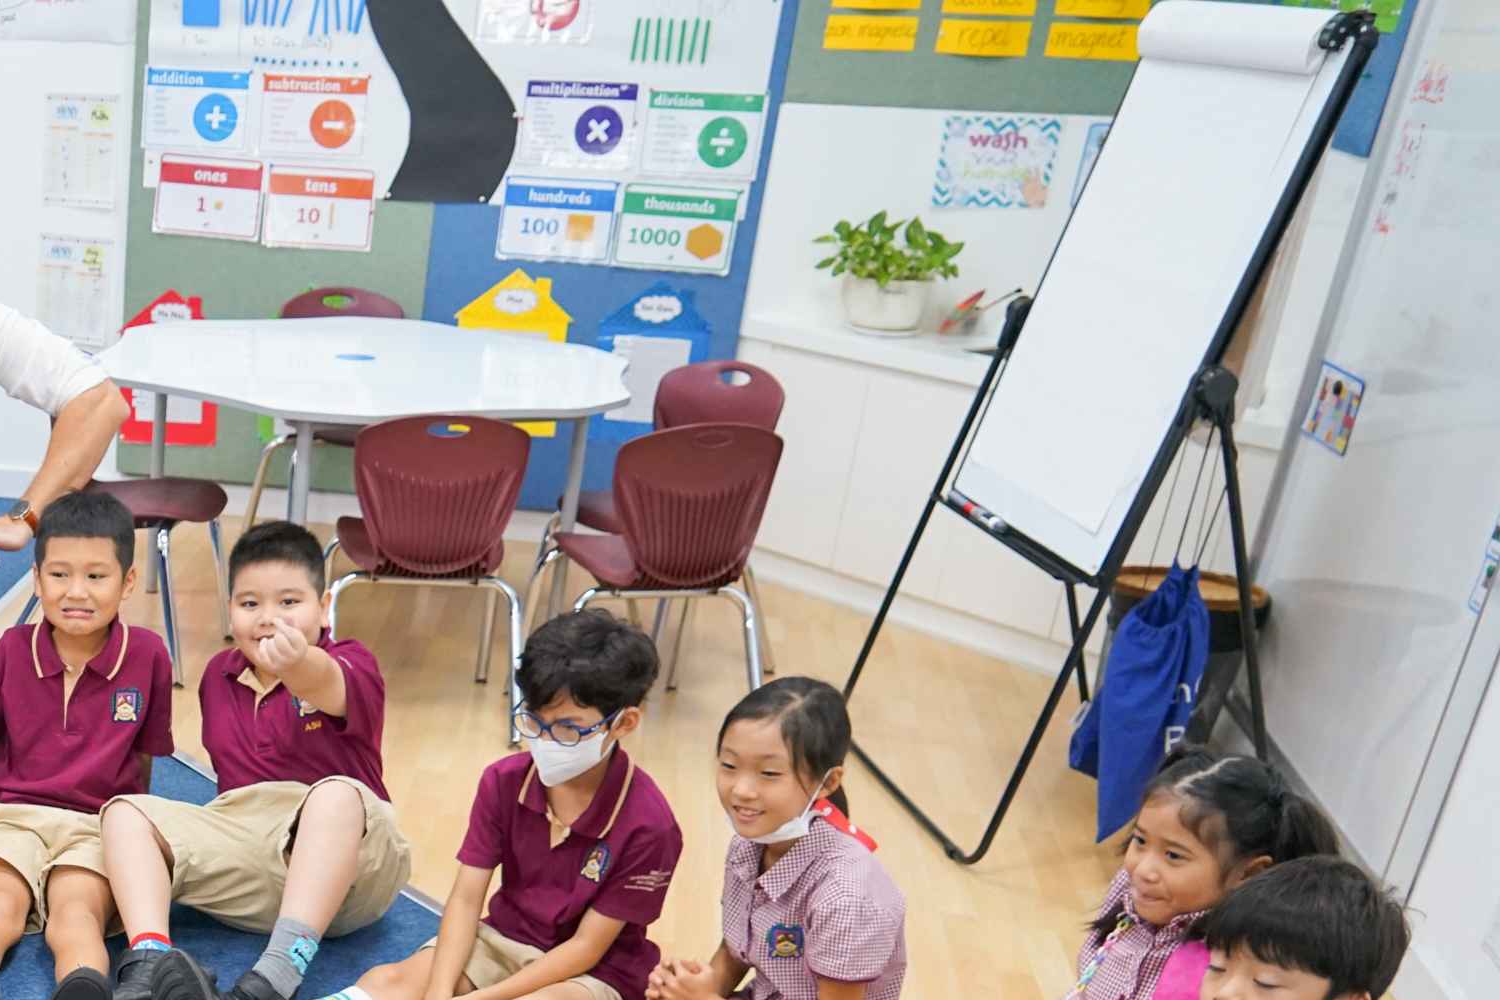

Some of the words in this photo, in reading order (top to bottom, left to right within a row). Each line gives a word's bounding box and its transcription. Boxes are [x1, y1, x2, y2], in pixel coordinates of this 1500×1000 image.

[957, 21, 1010, 50] repel
[1051, 30, 1128, 57] magnet
[151, 71, 204, 86] addition
[267, 78, 341, 92] subtraction
[530, 81, 620, 98] multiplication
[654, 93, 705, 107] division
[969, 131, 1029, 151] wash
[193, 170, 229, 184] ones
[304, 178, 338, 193] tens
[196, 197, 206, 213] 1
[528, 189, 592, 206] hundreds
[644, 196, 716, 215] thousands
[297, 207, 321, 225] 10
[520, 217, 560, 235] 100
[628, 227, 681, 246] 1000
